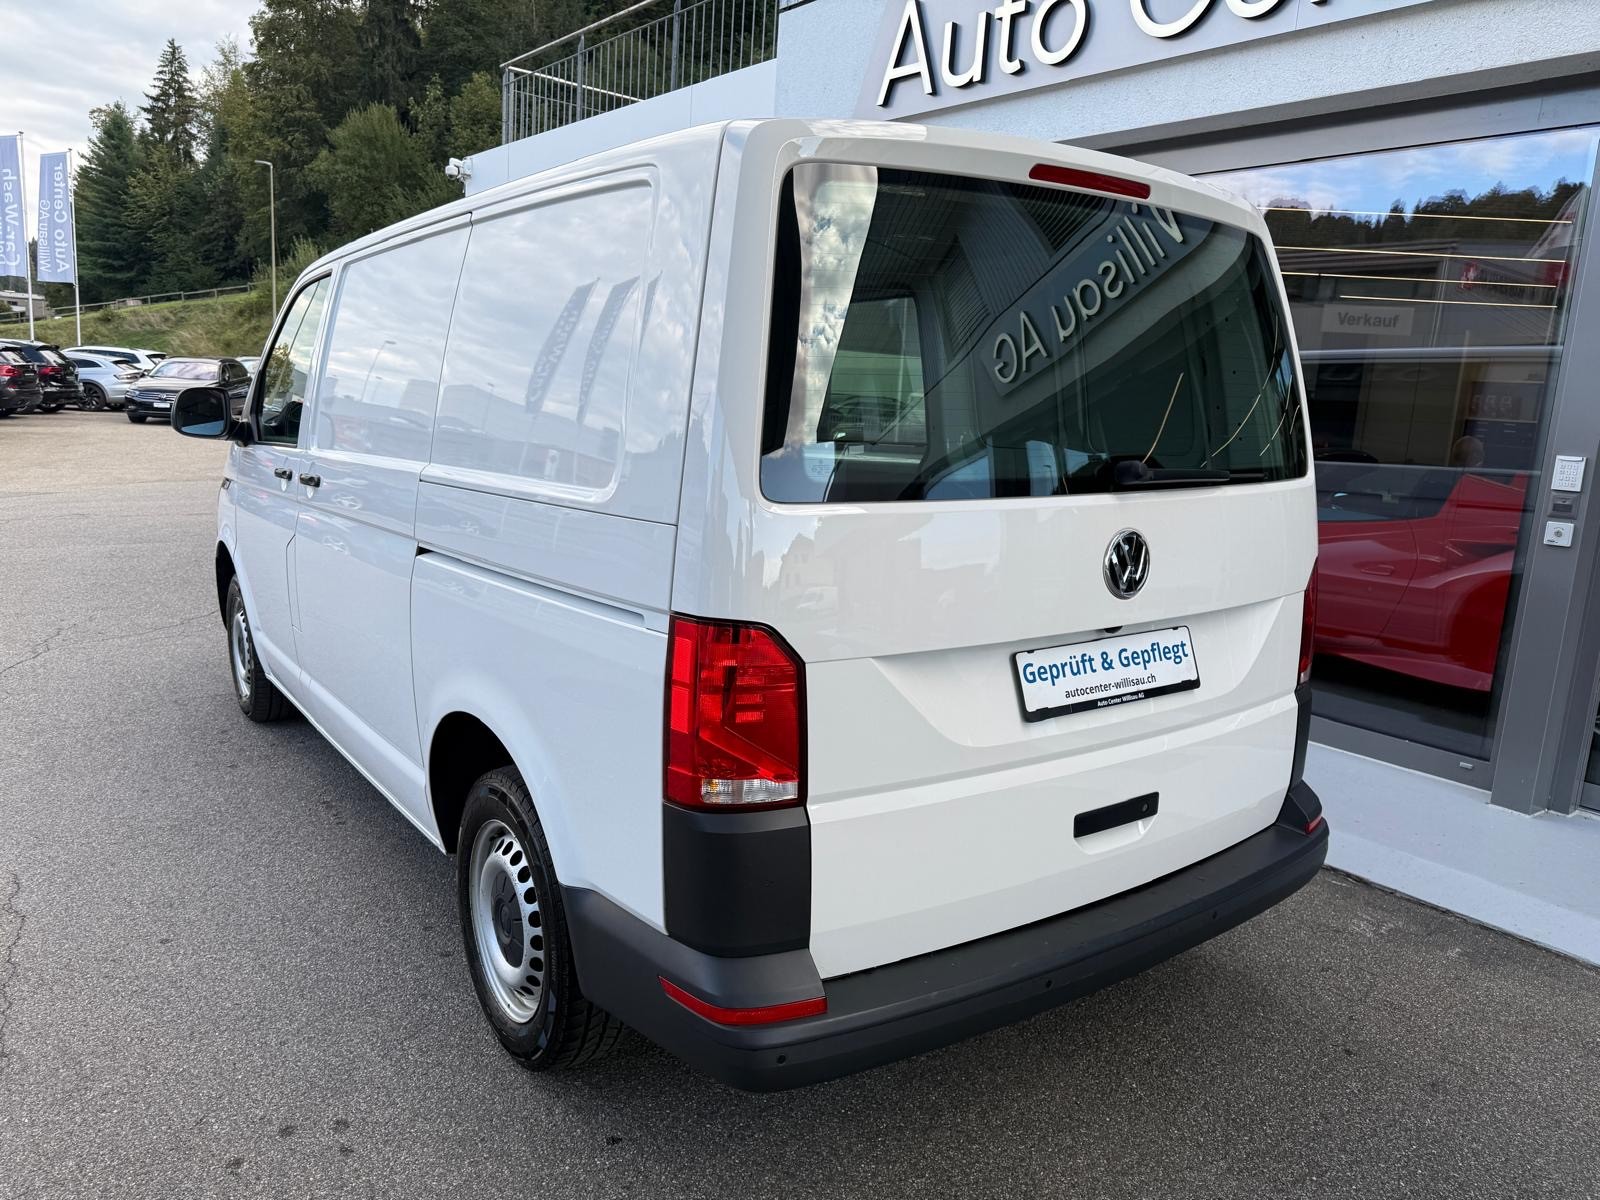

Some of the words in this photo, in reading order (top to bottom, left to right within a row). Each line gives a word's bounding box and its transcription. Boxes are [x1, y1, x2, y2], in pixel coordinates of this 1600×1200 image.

[876, 0, 1091, 107] Auto
[1337, 311, 1400, 328] Verkauf
[1023, 653, 1097, 686] Geprüft
[1101, 650, 1115, 671] &
[1118, 640, 1189, 670] Gepflegt
[1065, 673, 1157, 698] autocenter-willisau.ch
